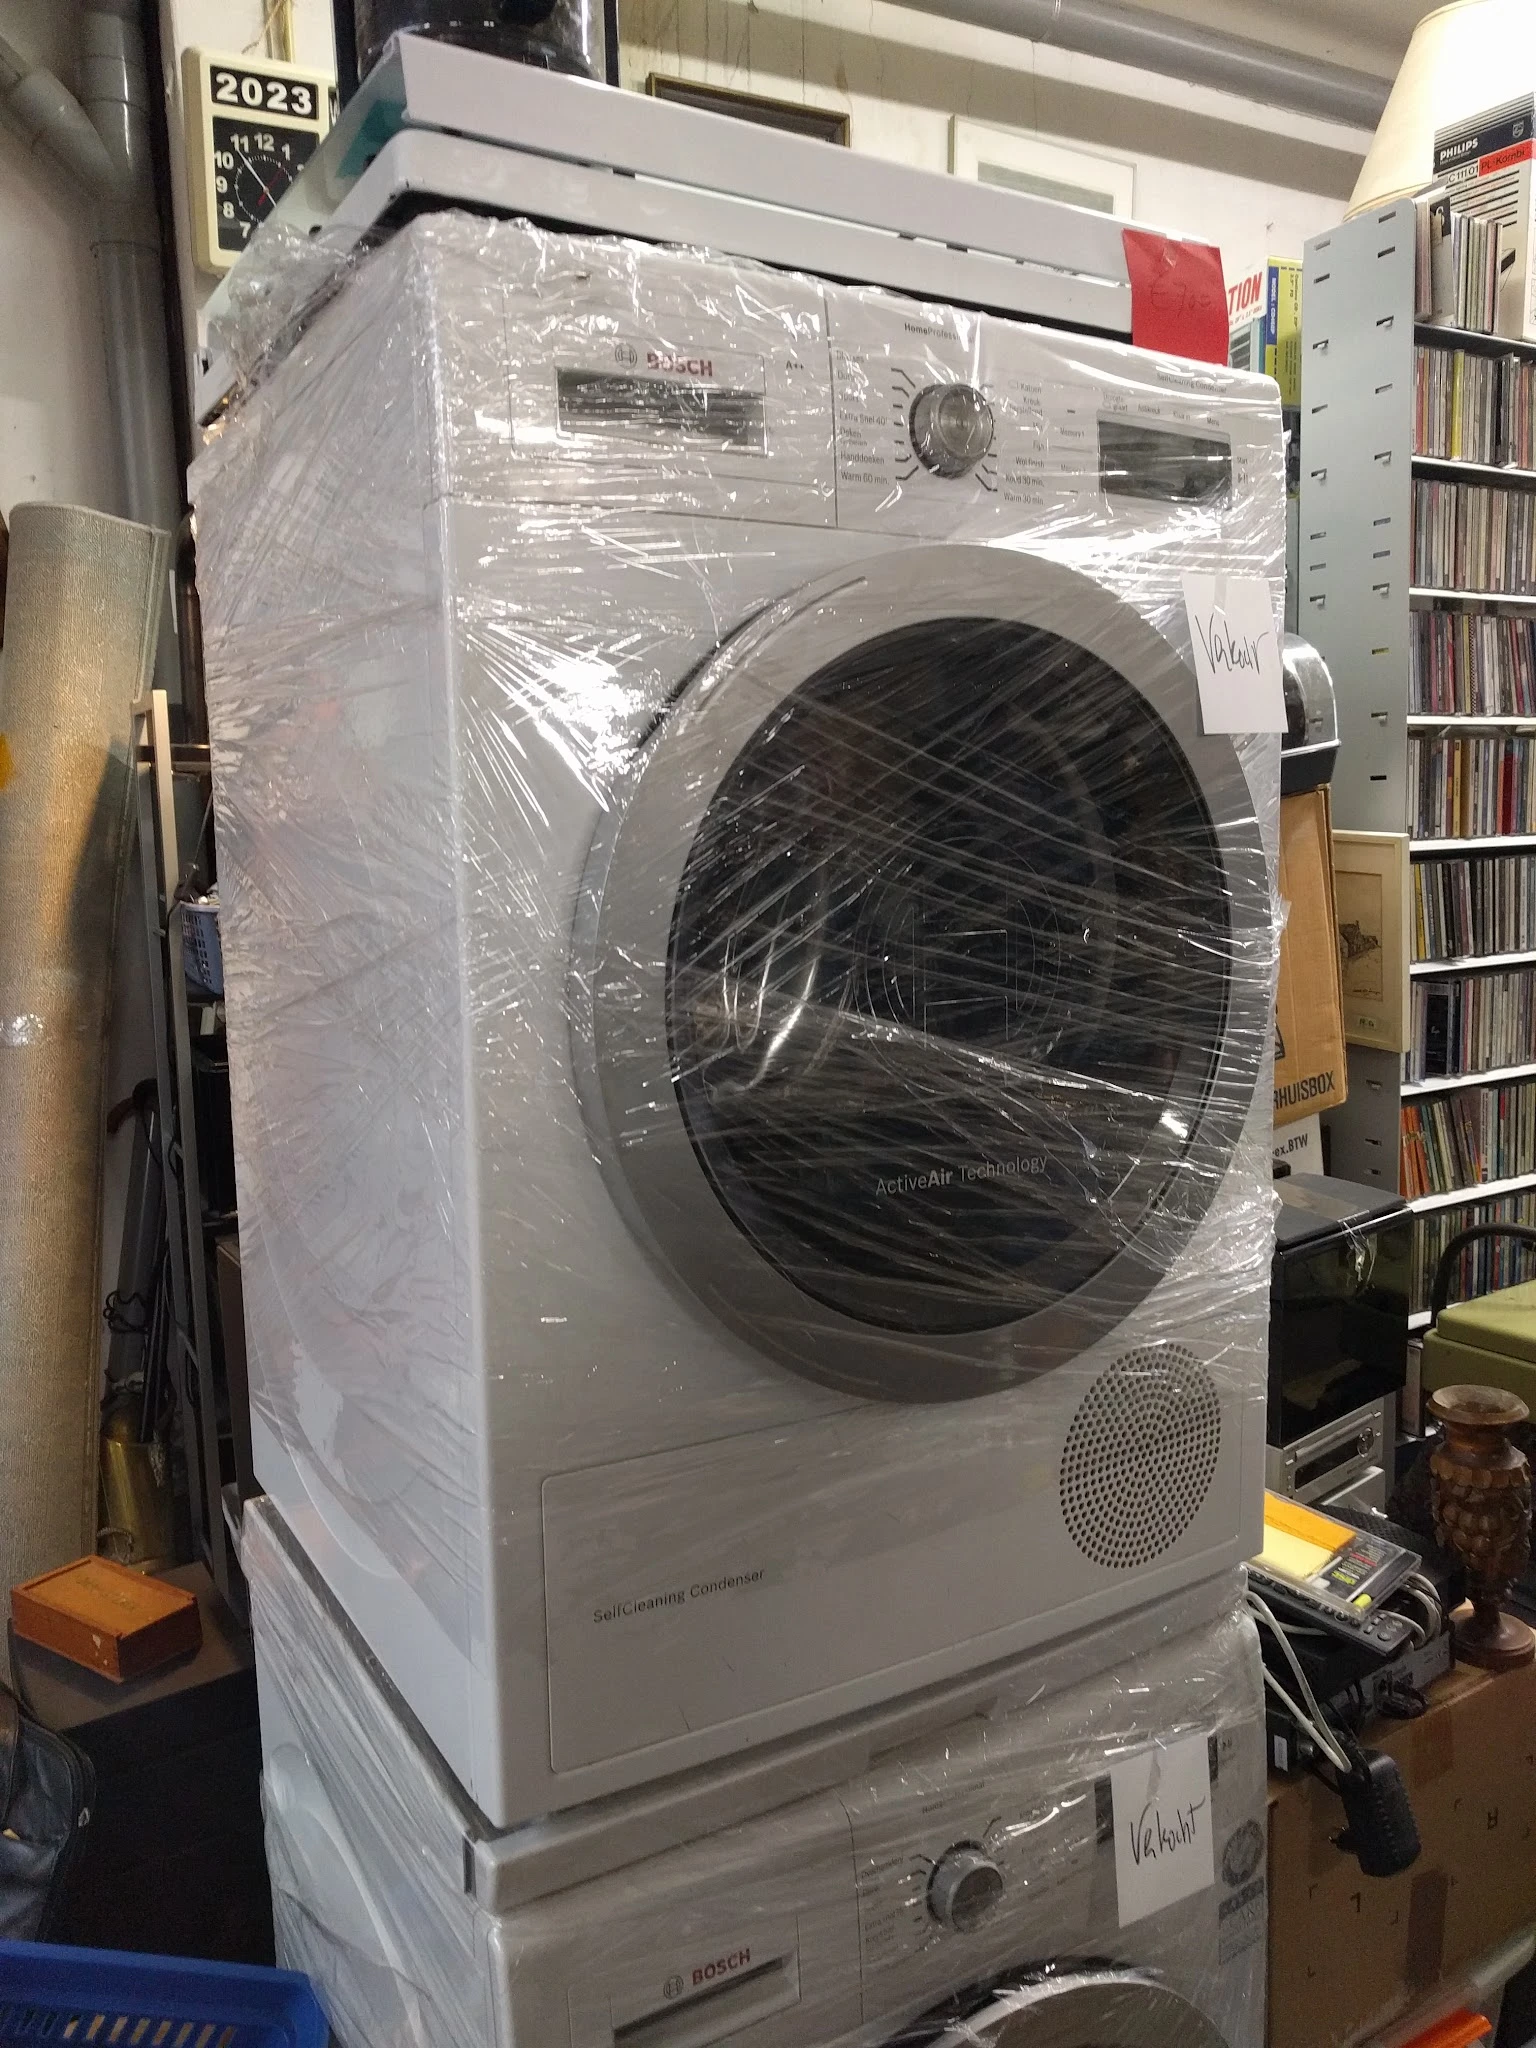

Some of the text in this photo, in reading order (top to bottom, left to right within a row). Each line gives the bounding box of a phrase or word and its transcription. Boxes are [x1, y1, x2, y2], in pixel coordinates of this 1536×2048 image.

[215, 72, 312, 116] 2023
[230, 133, 249, 153] 11
[254, 132, 275, 151] 12
[281, 143, 291, 160] 1
[1440, 138, 1479, 161] PHILIPS
[214, 151, 234, 169] 10
[216, 176, 227, 193] 9
[222, 201, 234, 219] 8
[239, 221, 251, 238] 7
[1228, 271, 1263, 316] TION
[646, 351, 713, 377] BOSCH
[840, 450, 885, 464] Handdoeken
[841, 470, 862, 482] Warm
[1004, 491, 1022, 502] Warm
[1274, 1070, 1336, 1110] RHUISBOX
[1274, 1133, 1309, 1157] ex.BTW
[876, 1155, 1048, 1196] ActiveAir Technology
[593, 1569, 765, 1624] SelfCleaning Condenser
[692, 1948, 751, 1986] BOSCH
